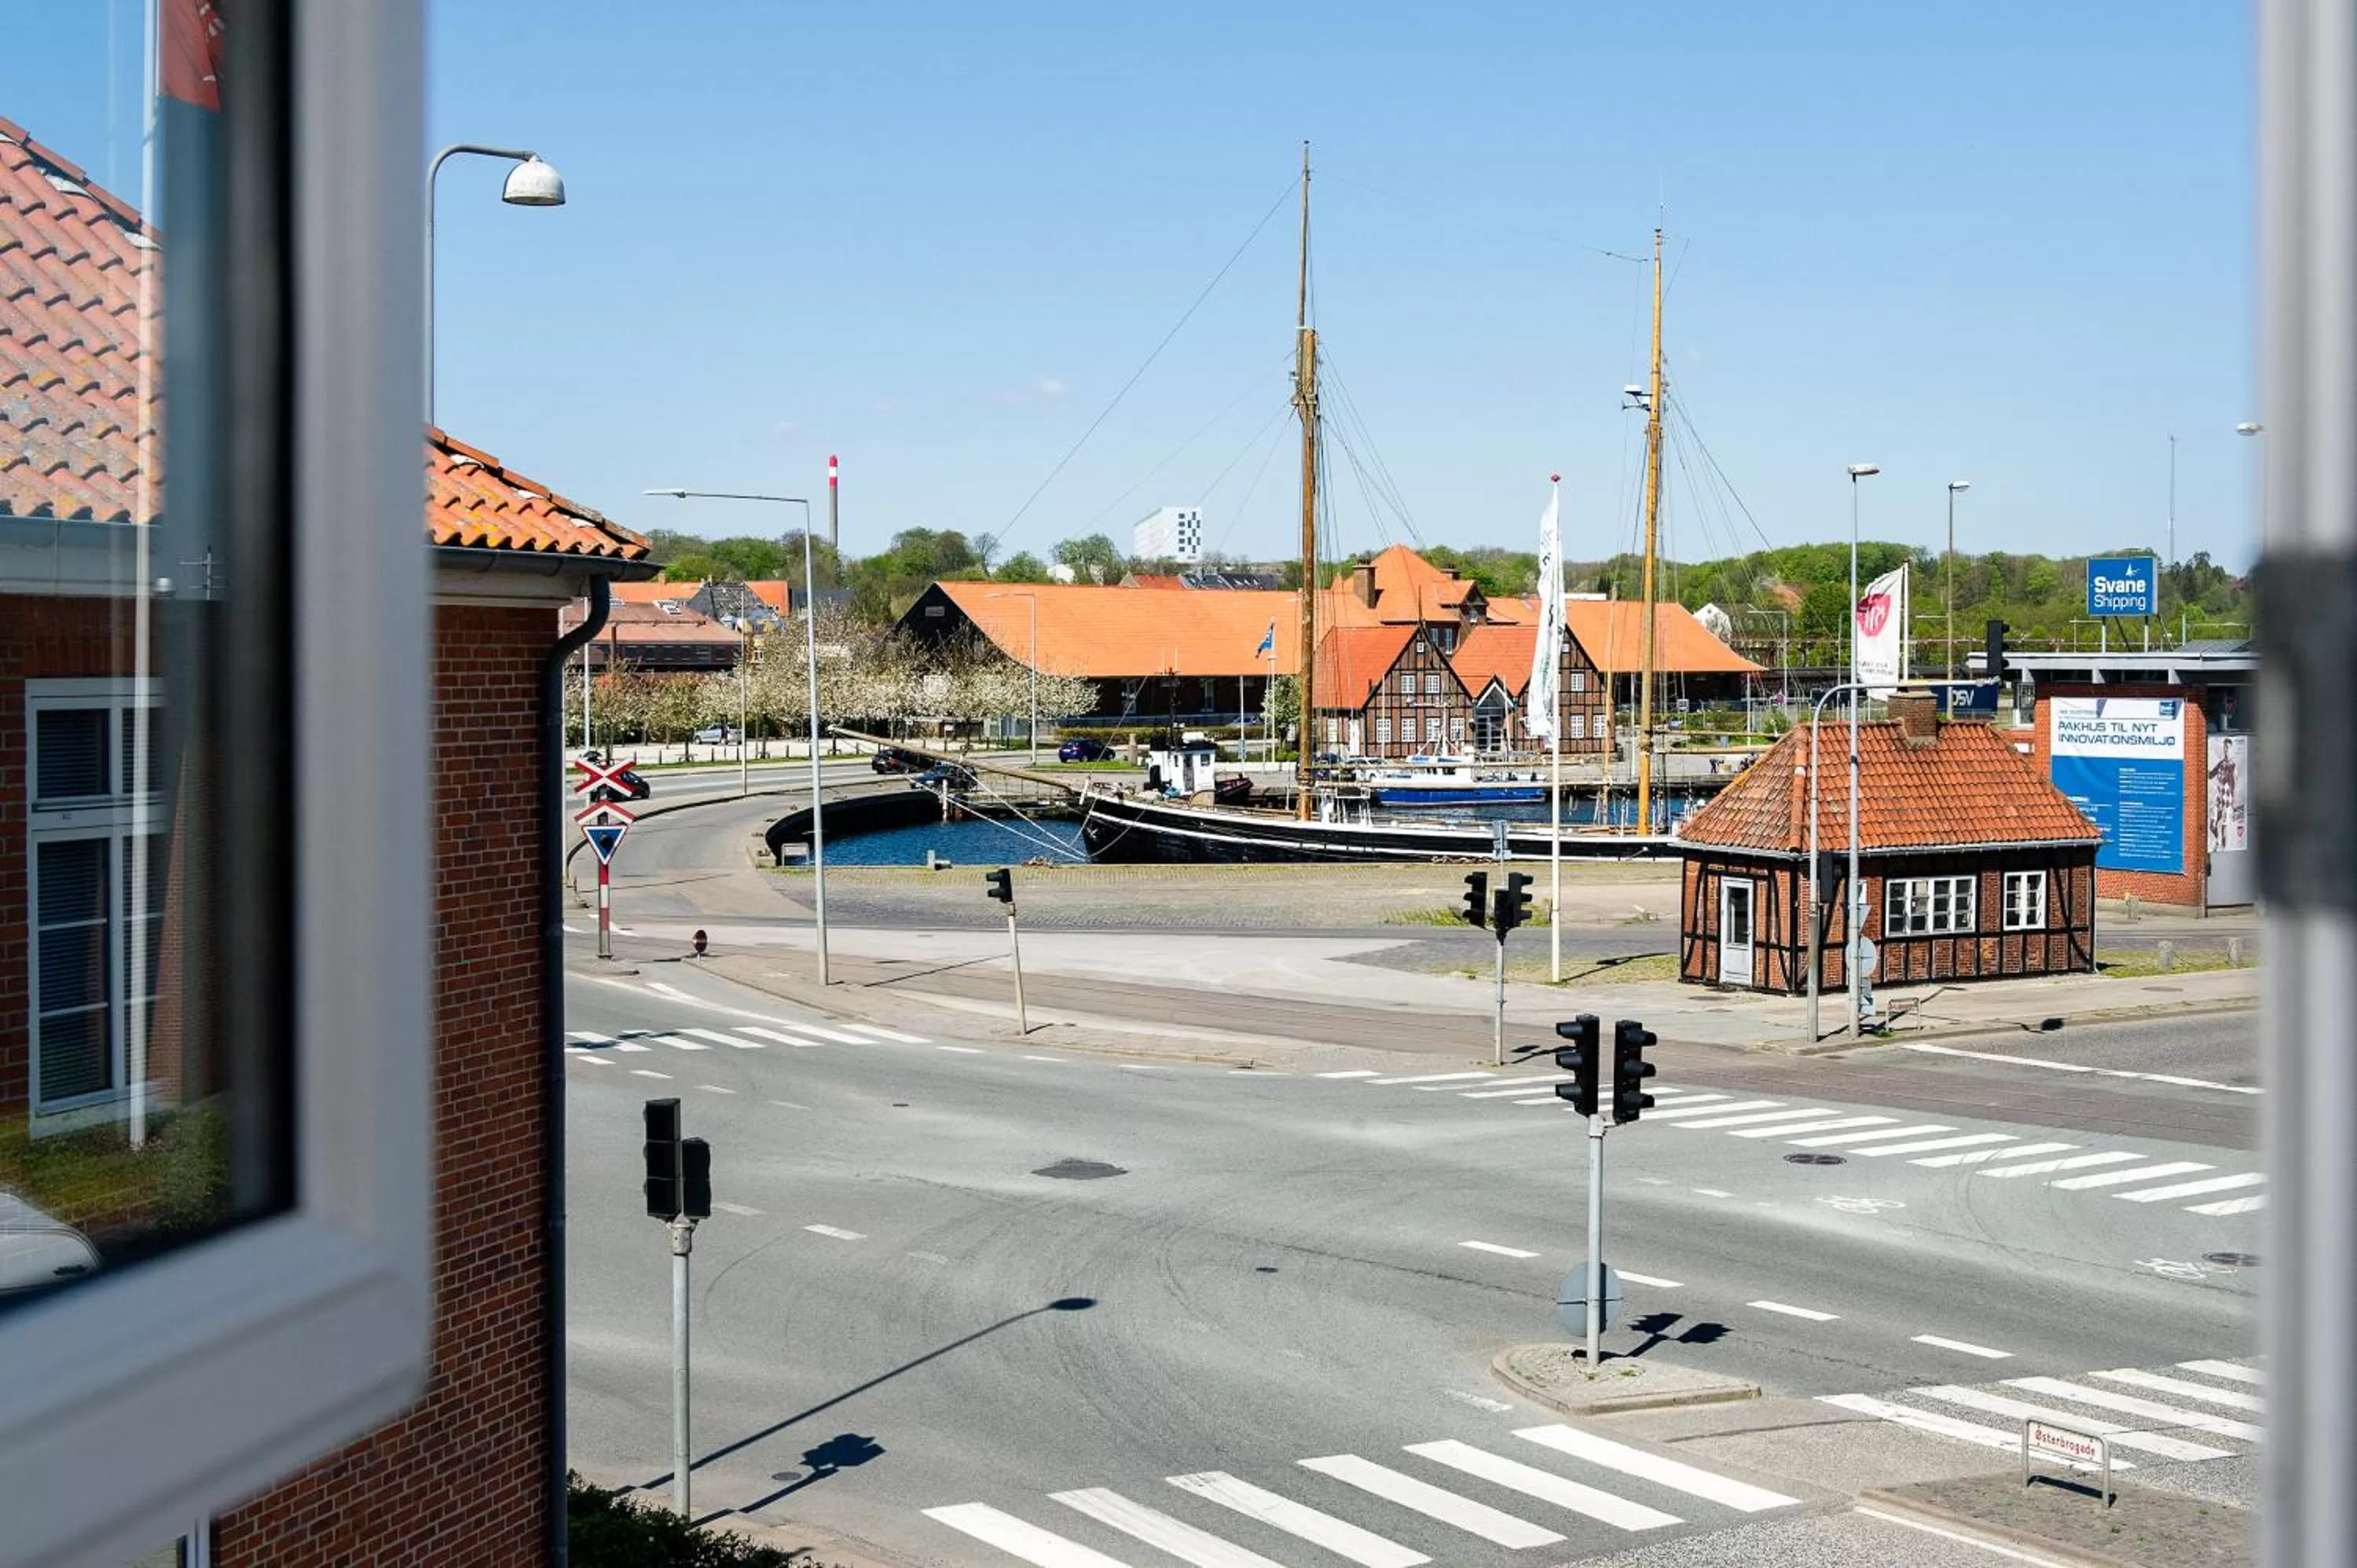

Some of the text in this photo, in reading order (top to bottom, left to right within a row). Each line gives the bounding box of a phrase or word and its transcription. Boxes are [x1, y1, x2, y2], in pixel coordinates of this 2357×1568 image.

[2094, 576, 2146, 593] Svane
[2094, 594, 2146, 611] Shipping
[2058, 720, 2158, 733] PAKHUS TIL NYT
[2058, 733, 2176, 746] INNOVATIONSMILJØ
[2035, 1429, 2095, 1456] Østerbrogade
